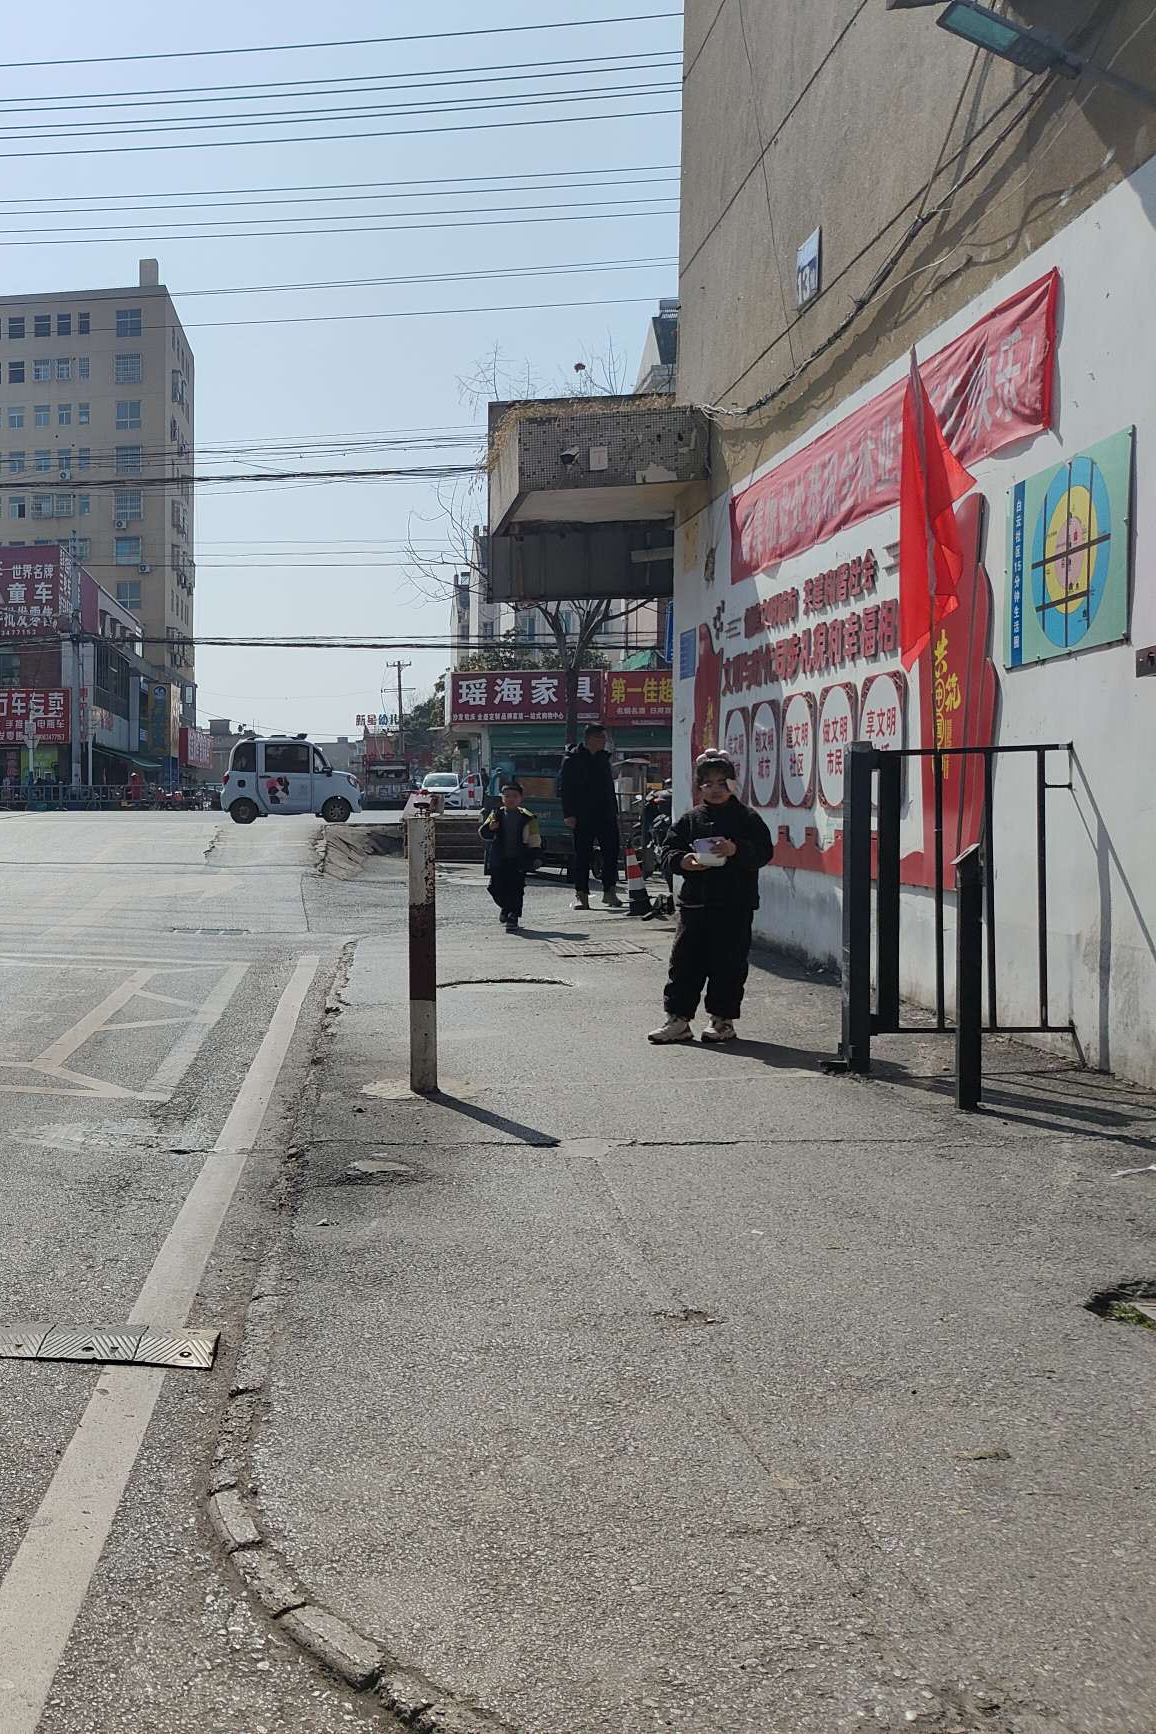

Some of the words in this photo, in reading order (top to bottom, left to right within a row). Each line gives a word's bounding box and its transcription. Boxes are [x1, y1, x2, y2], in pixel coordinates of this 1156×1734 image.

[12, 564, 54, 579] 世界名牌
[458, 676, 594, 706] 瑶海家具
[866, 707, 897, 739] 享文明
[827, 749, 843, 776] 市民
